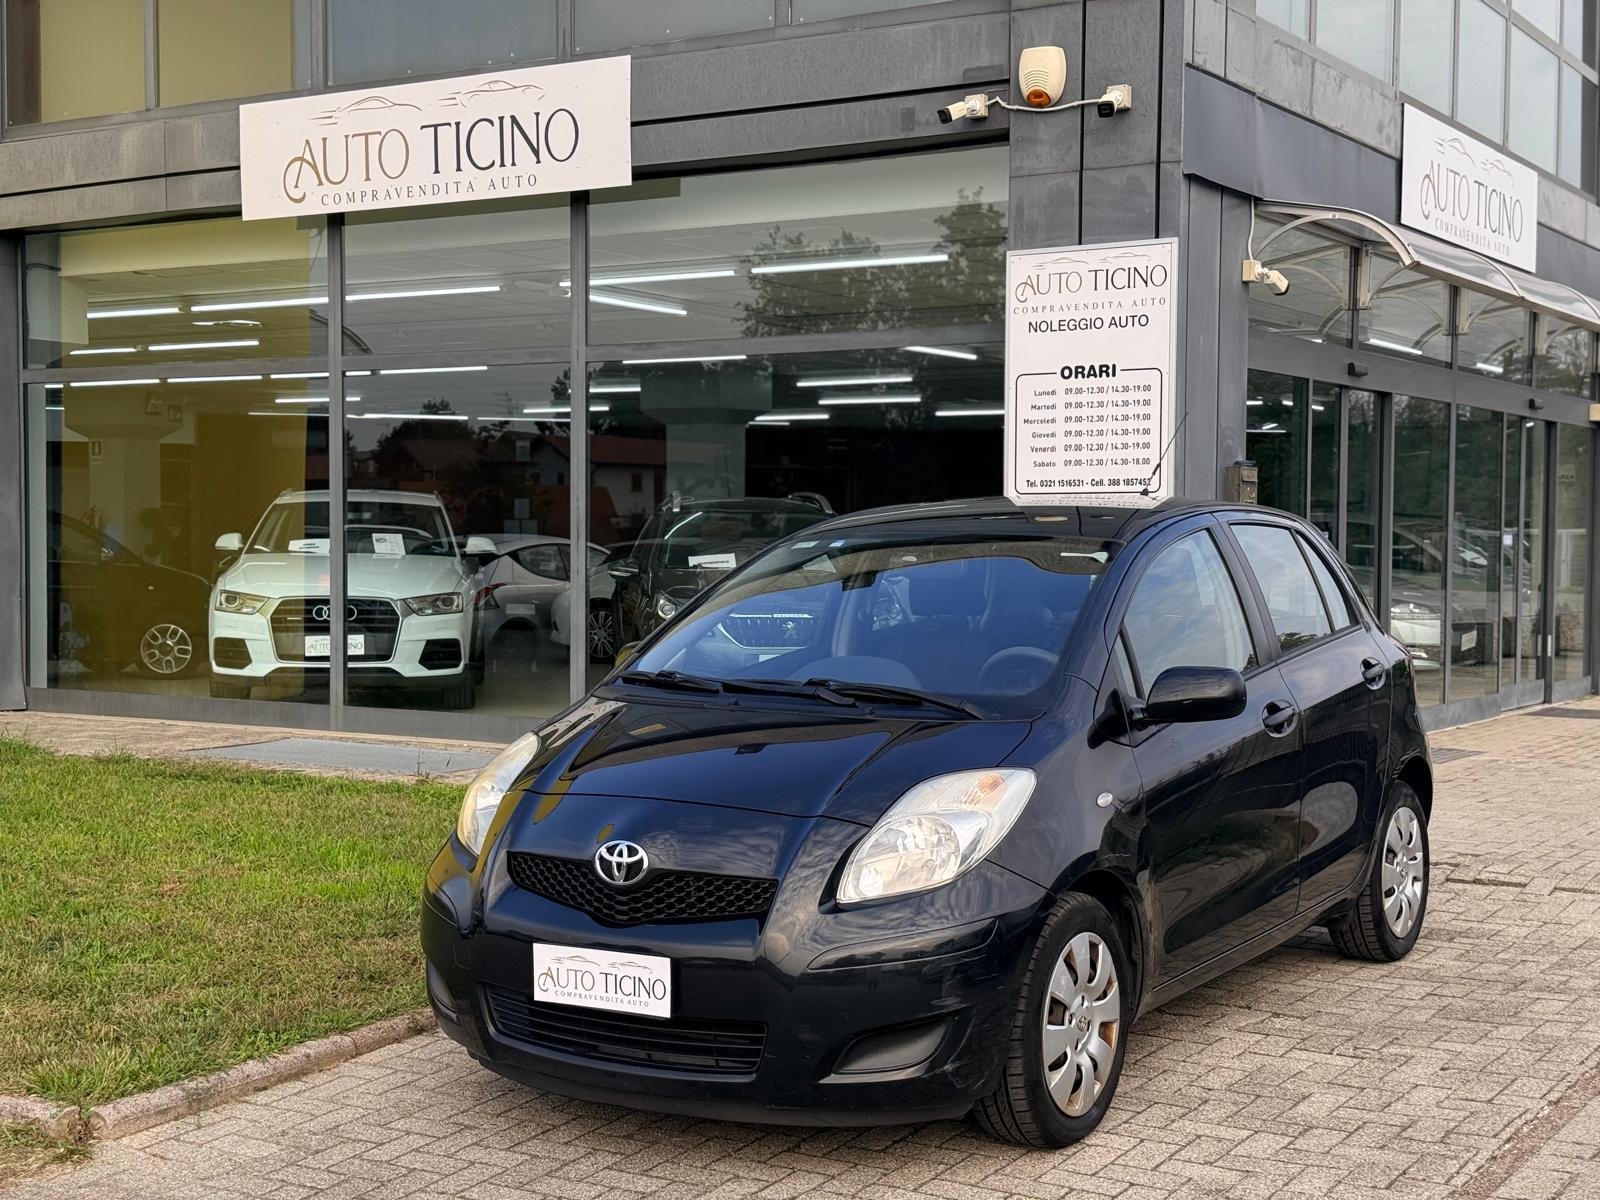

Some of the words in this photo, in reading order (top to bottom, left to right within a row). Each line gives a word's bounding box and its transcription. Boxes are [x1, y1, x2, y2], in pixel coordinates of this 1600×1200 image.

[283, 128, 410, 204] AUTO
[420, 108, 580, 175] TICINO
[321, 179, 475, 206] COMPRAVENDITA
[488, 173, 538, 191] AUTO
[1420, 160, 1470, 221] AUTO
[1474, 180, 1523, 242] TICINO
[1015, 271, 1083, 303] AUTO
[1088, 264, 1168, 291] TICINO
[1013, 300, 1123, 315] COMPRAVENDITA
[1131, 297, 1166, 308] AUTO
[1028, 317, 1104, 333] NOLEGGIO
[1108, 314, 1149, 330] AUTO
[1060, 363, 1117, 380] ORARI
[1064, 386, 1105, 396] 09.00-12.30
[1111, 384, 1152, 393] 14.30-19.00
[1064, 401, 1105, 410] 09.00-12.30
[1111, 398, 1151, 408] 14.30-19.00
[1064, 415, 1104, 424] 09.00-12.30
[1111, 413, 1151, 422] 14.30-19.00
[1064, 429, 1104, 438] 09.00-12.30
[1111, 428, 1151, 436] 14.30-19.00
[1063, 443, 1104, 452] 09.00-12.30
[1110, 441, 1151, 450] 14.30-19.00
[1033, 460, 1057, 468] Sabato
[1063, 459, 1104, 467] 09.00-12.30
[1110, 457, 1151, 466] 14.30-18.00
[1026, 480, 1038, 488] Tel.
[1040, 479, 1056, 488] 0321
[1090, 478, 1106, 487] Cell.
[537, 966, 595, 992] AUTO
[600, 971, 667, 1001] TICINO
[554, 989, 624, 1005] COMPRAVENDITA
[627, 999, 650, 1008] AUTO
